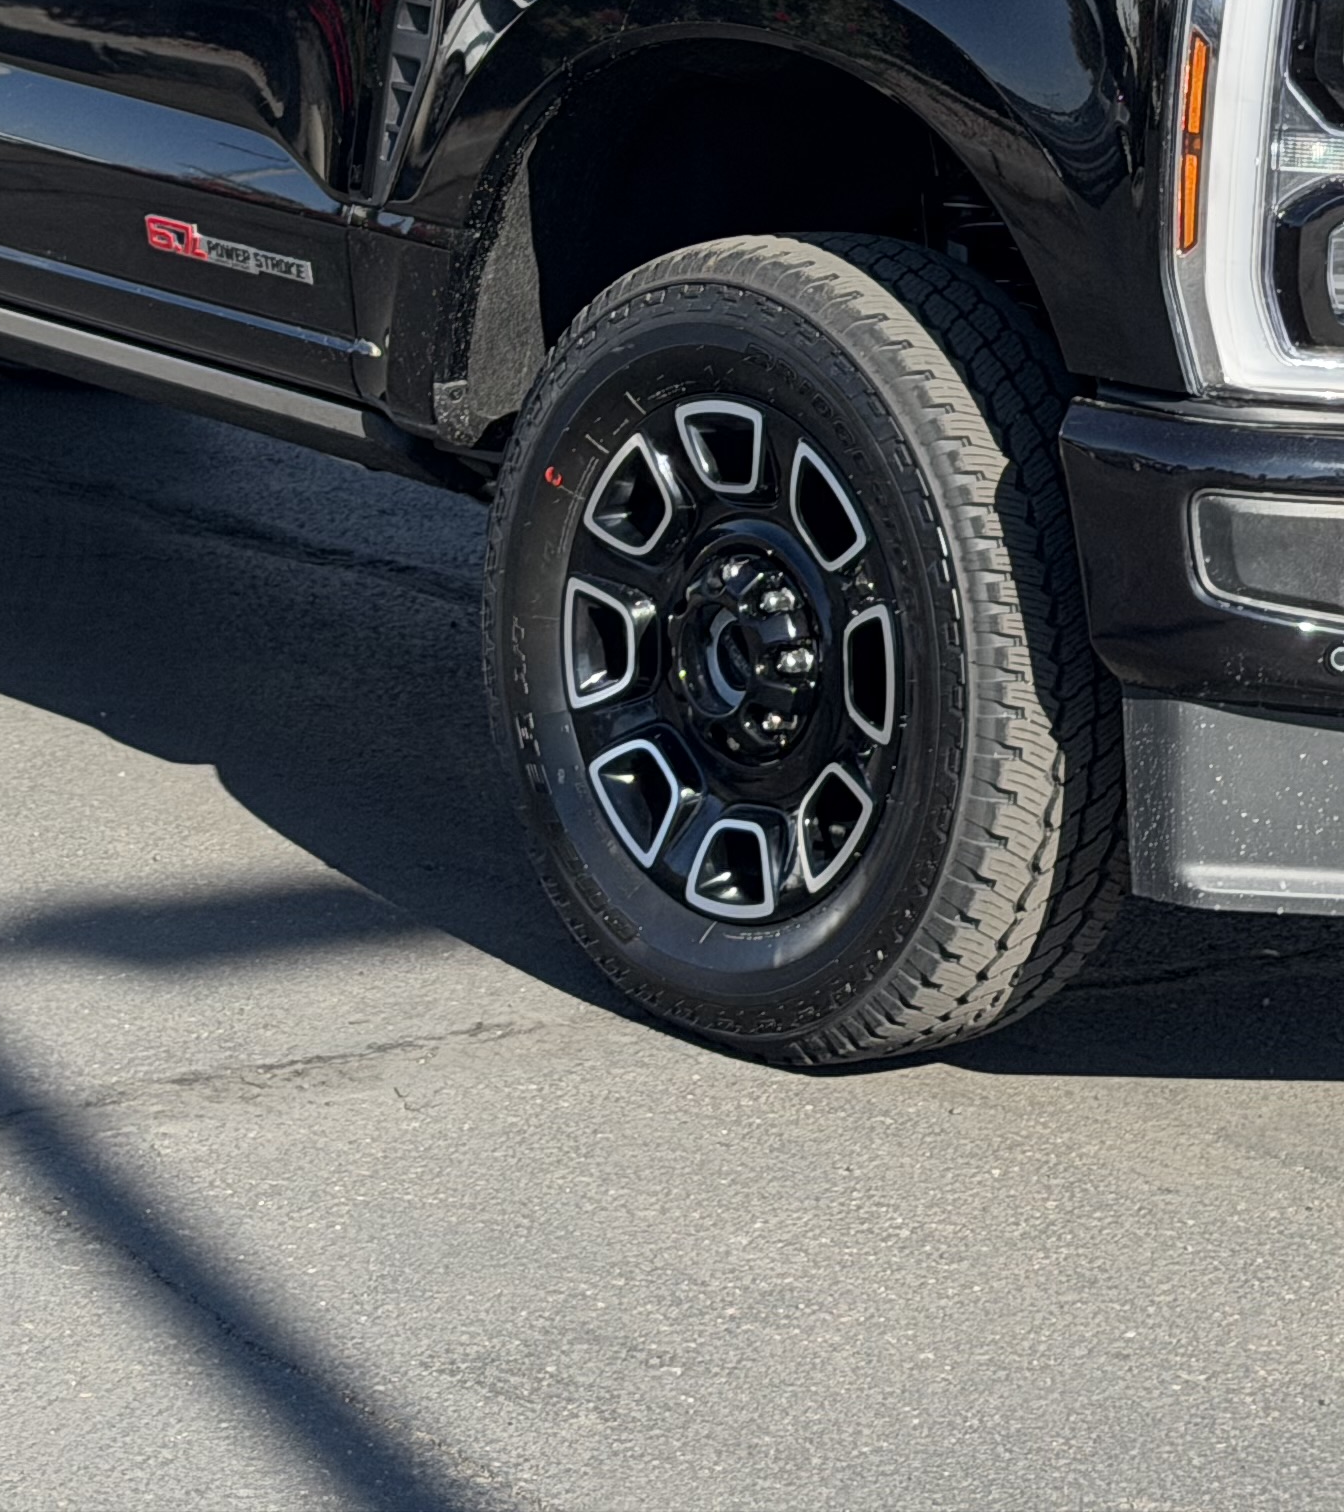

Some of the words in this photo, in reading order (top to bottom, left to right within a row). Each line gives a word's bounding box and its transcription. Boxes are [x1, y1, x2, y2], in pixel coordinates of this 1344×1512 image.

[144, 213, 209, 262] 6.7L
[206, 239, 251, 264] POWER
[253, 251, 306, 280] STROKE
